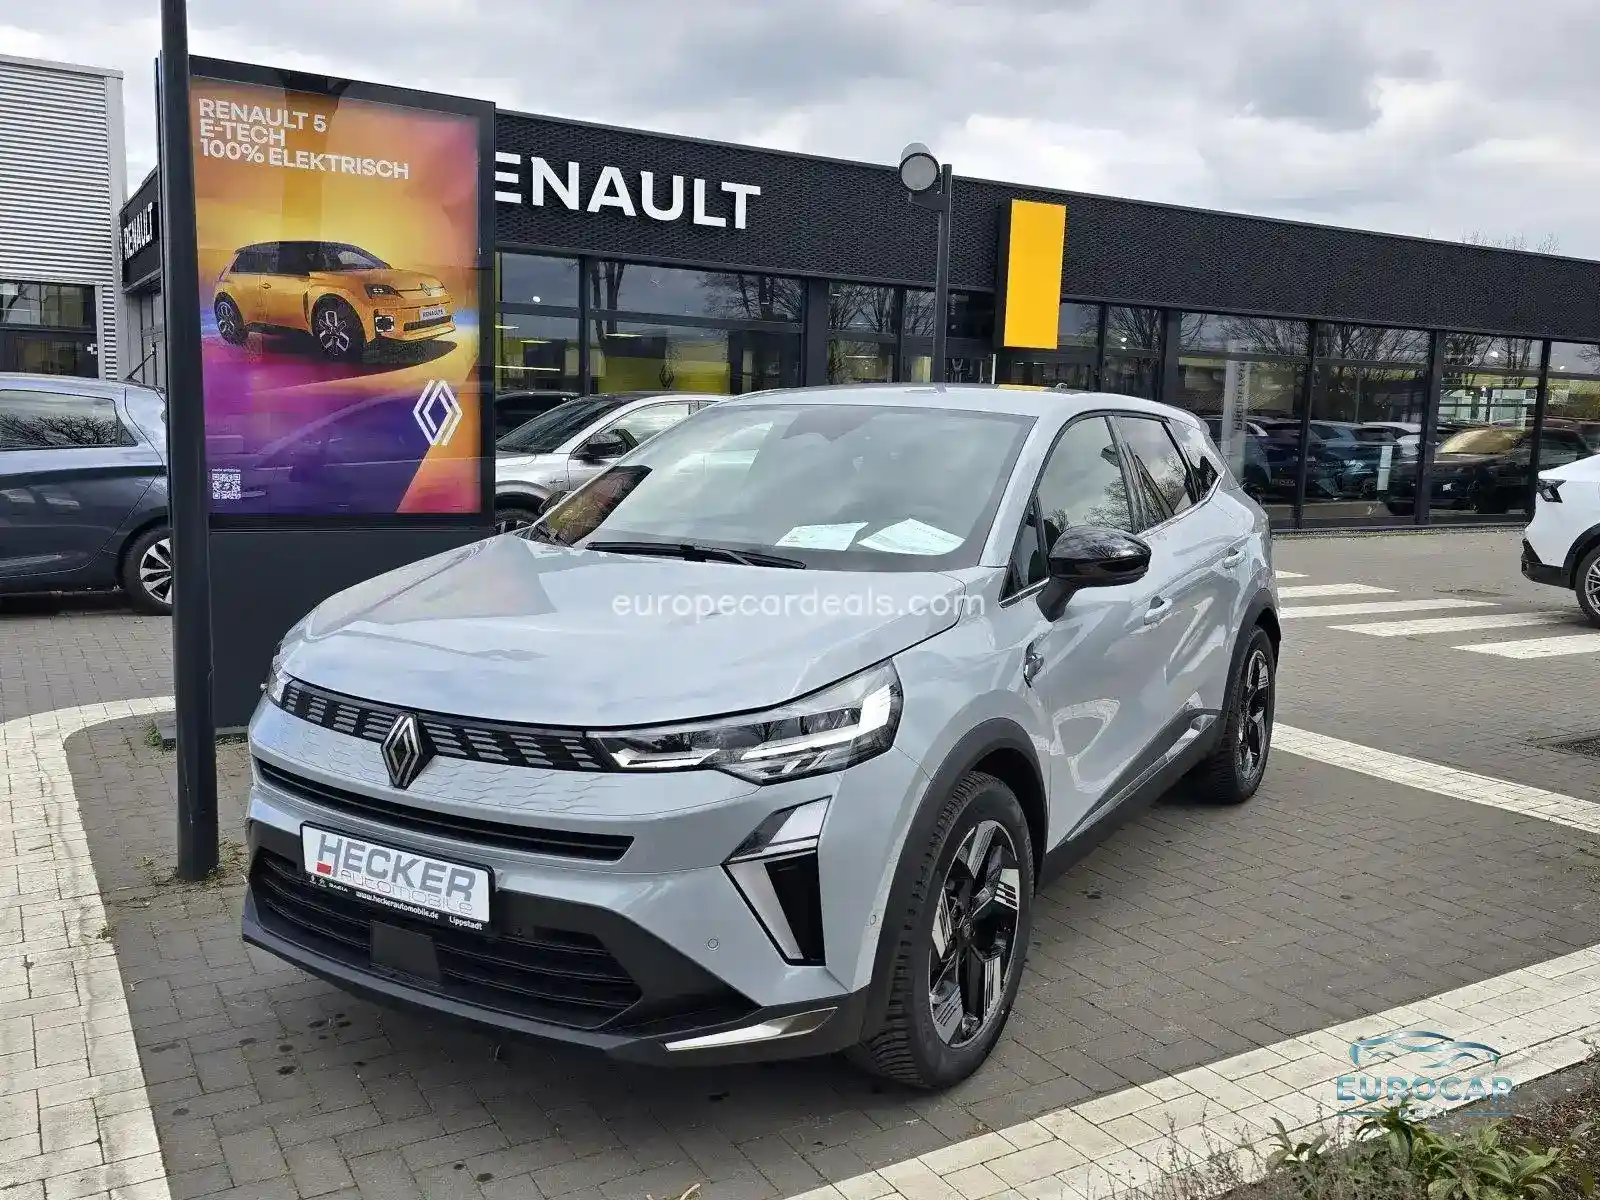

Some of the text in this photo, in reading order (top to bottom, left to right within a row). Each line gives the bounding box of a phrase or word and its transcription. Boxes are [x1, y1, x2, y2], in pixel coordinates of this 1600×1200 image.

[199, 98, 327, 132] RENAULT 5
[200, 119, 286, 146] E-TECH
[200, 138, 409, 179] 100% ELEKTRISCH
[495, 151, 761, 230] ENAULT
[316, 833, 477, 902] HECKER
[355, 890, 439, 919] www.heckerautomobile.de
[449, 915, 483, 930] Lippstadt
